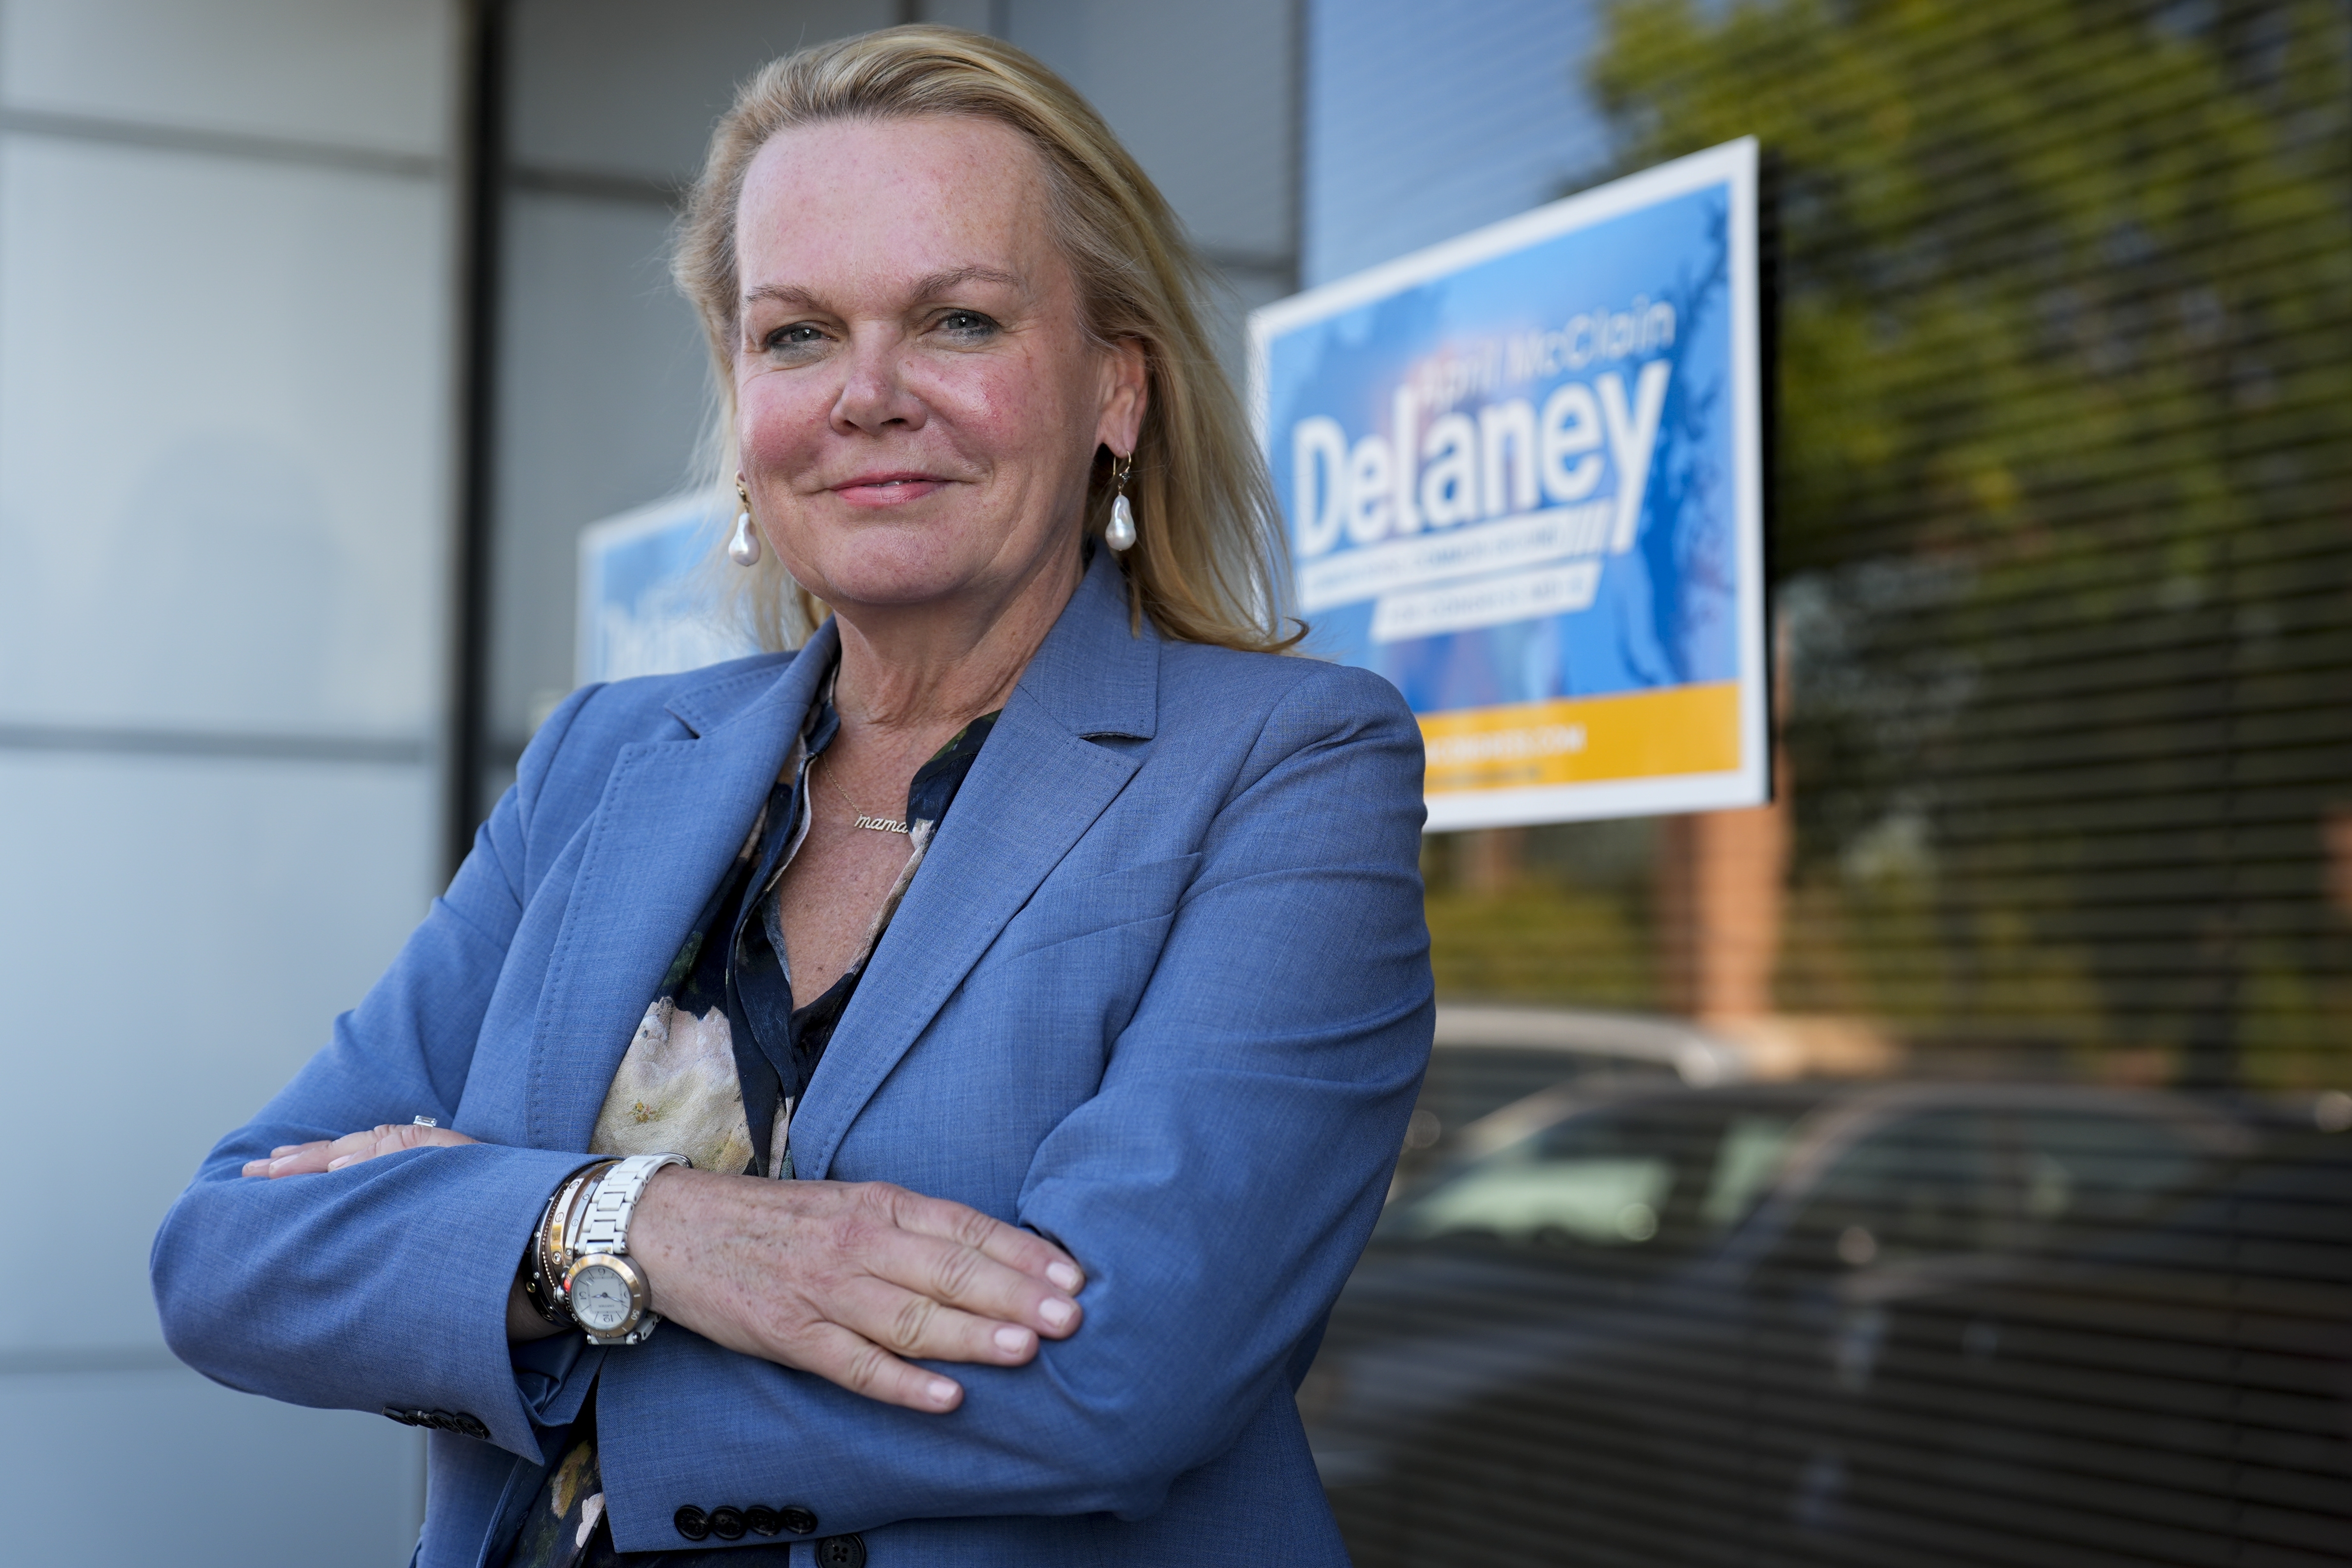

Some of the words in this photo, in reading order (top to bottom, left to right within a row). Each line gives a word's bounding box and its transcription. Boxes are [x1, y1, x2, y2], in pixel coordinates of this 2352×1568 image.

[1508, 296, 1676, 377] McClain
[1292, 361, 1673, 556] Delaney
[854, 814, 909, 834] mama
[579, 1291, 587, 1300] 3
[602, 1314, 614, 1323] 12
[631, 1309, 639, 1321] 50
